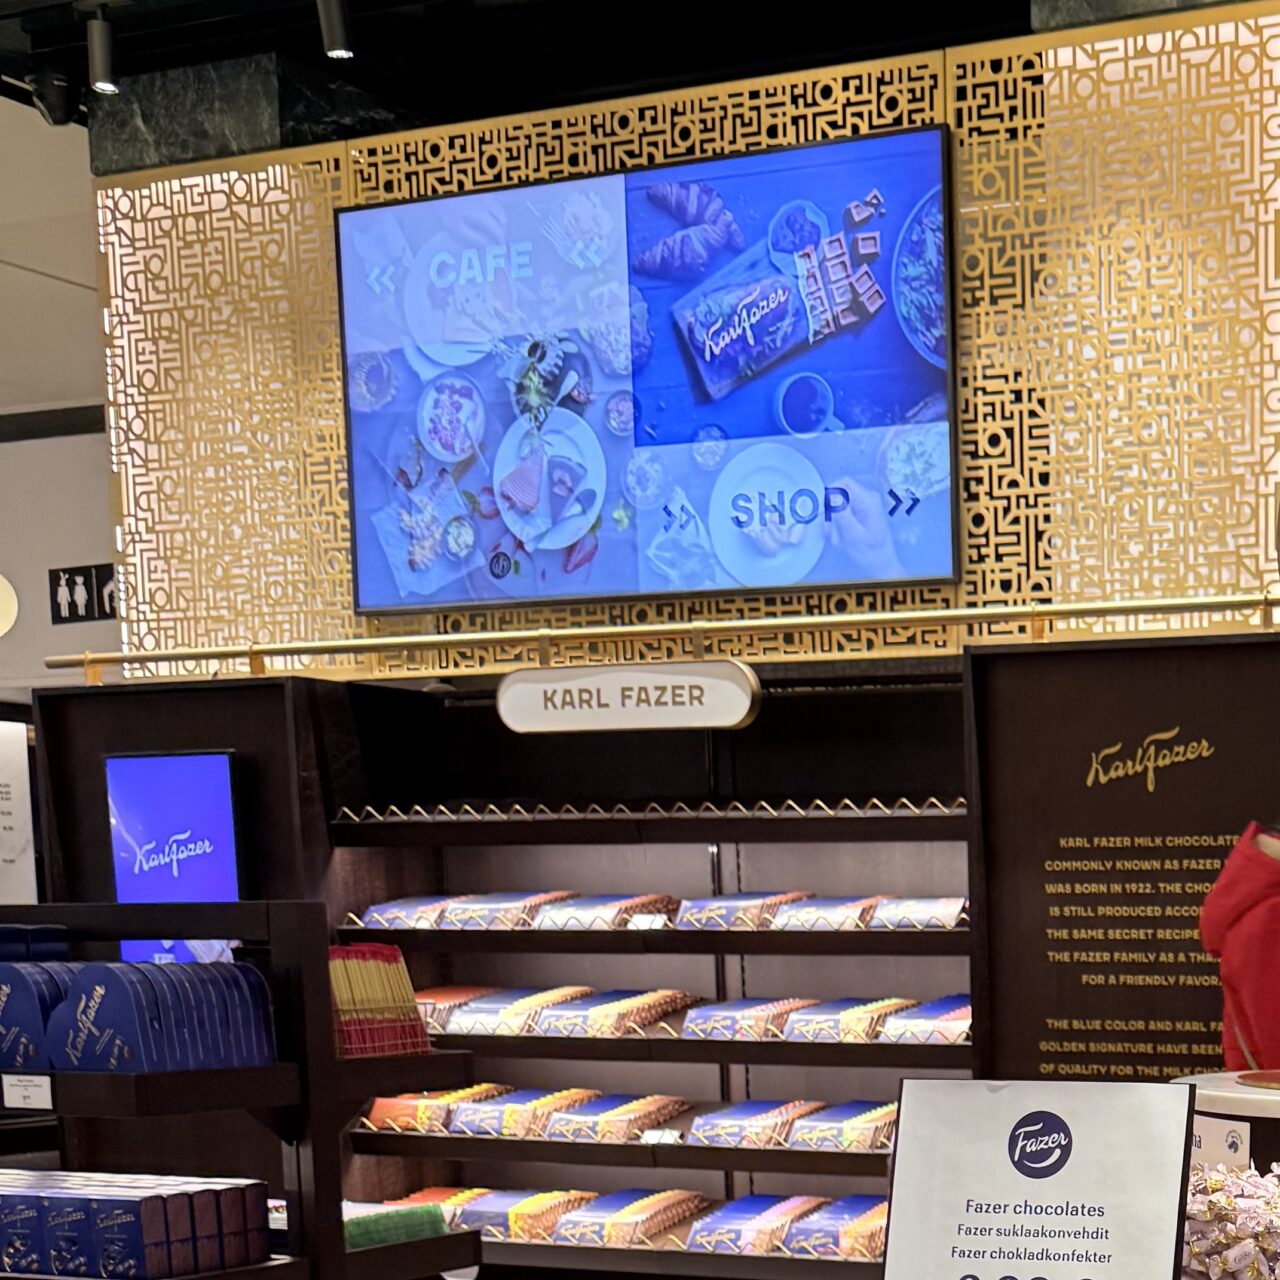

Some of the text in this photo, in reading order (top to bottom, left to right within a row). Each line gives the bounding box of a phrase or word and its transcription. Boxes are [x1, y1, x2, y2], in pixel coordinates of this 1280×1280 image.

[429, 241, 534, 289] CAFE
[731, 487, 850, 529] SHOP
[543, 684, 705, 711] KARL FAZER
[1059, 836, 1091, 849] KARL
[1093, 836, 1131, 848] FAZER
[1134, 836, 1163, 847] MILK
[1044, 859, 1221, 872] COMMONLY KNOWN AS FAZER
[1045, 883, 1072, 894] WAS
[1074, 883, 1107, 894] BORN
[1110, 883, 1122, 894] IN
[1125, 883, 1156, 894] 1922.
[1158, 883, 1182, 893] THE
[1049, 906, 1060, 917] IS
[1063, 906, 1095, 917] STILL
[1097, 906, 1162, 917] PRODUCED
[1046, 929, 1069, 940] THE
[1071, 929, 1105, 940] SAME
[1107, 929, 1154, 940] SECRET
[1047, 951, 1070, 963] THE
[1073, 951, 1111, 963] FAZER
[1113, 951, 1155, 963] FAMILY
[1159, 952, 1174, 963] AS
[1177, 952, 1186, 963] A
[1081, 974, 1106, 986] FOR
[1108, 974, 1117, 985] A
[1119, 974, 1176, 986] FRIENDLY
[1045, 1018, 1069, 1030] THE
[1071, 1019, 1102, 1030] BLUE
[1104, 1019, 1145, 1031] COLOR
[1148, 1020, 1173, 1031] AND
[1175, 1020, 1207, 1032] KARL
[1039, 1041, 1087, 1053] GOLDEN
[1088, 1042, 1154, 1054] SIGNATURE
[1156, 1043, 1188, 1055] HAVE
[1039, 1063, 1054, 1075] OF
[1057, 1064, 1107, 1075] QUALITY
[1110, 1064, 1134, 1076] FOR
[1137, 1065, 1160, 1076] THE
[1013, 1121, 1069, 1163] Fazer
[965, 1199, 1105, 1218] Fazer chocolates
[957, 1223, 1110, 1241] Fazer suklaakonvehdit
[951, 1246, 1113, 1264] Fazer chokladkonfekter
